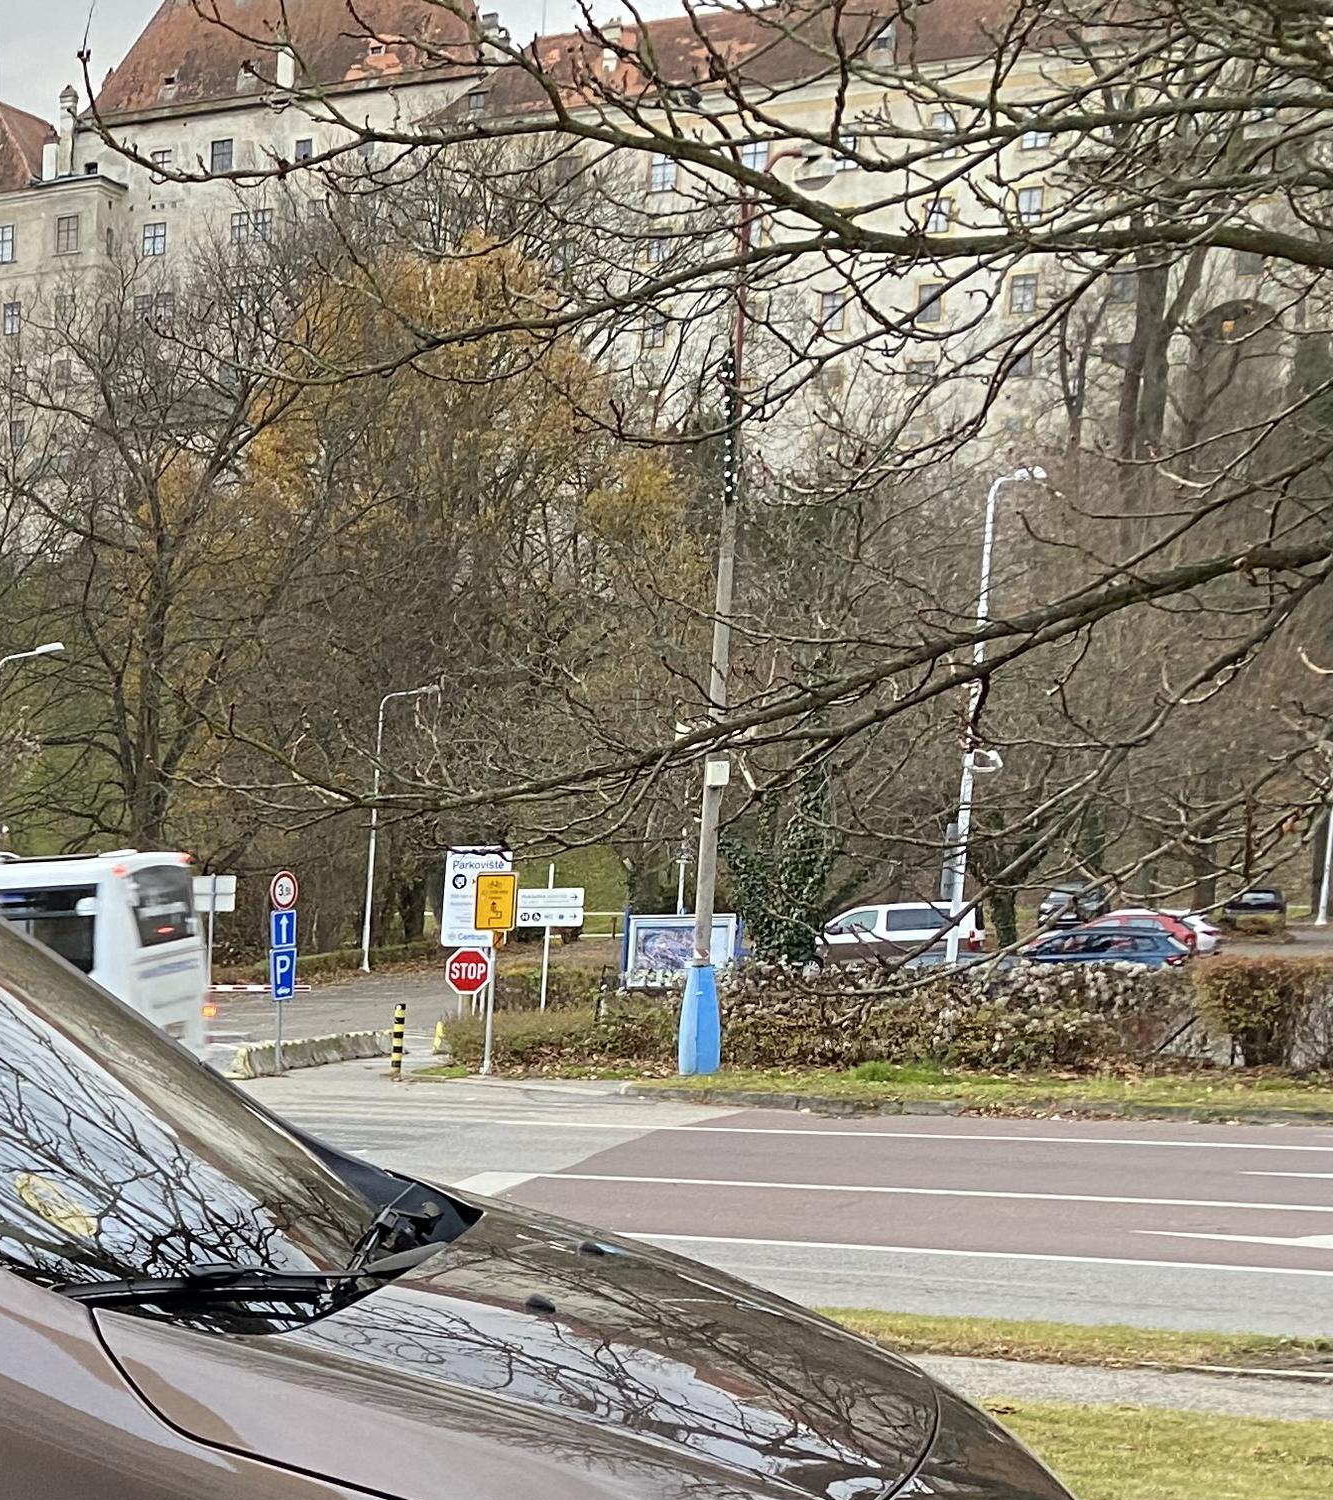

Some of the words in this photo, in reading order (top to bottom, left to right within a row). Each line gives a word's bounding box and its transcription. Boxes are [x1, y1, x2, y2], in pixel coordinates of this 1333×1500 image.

[452, 860, 505, 870] Parkoviště
[276, 955, 290, 985] P
[450, 962, 487, 980] STOP
